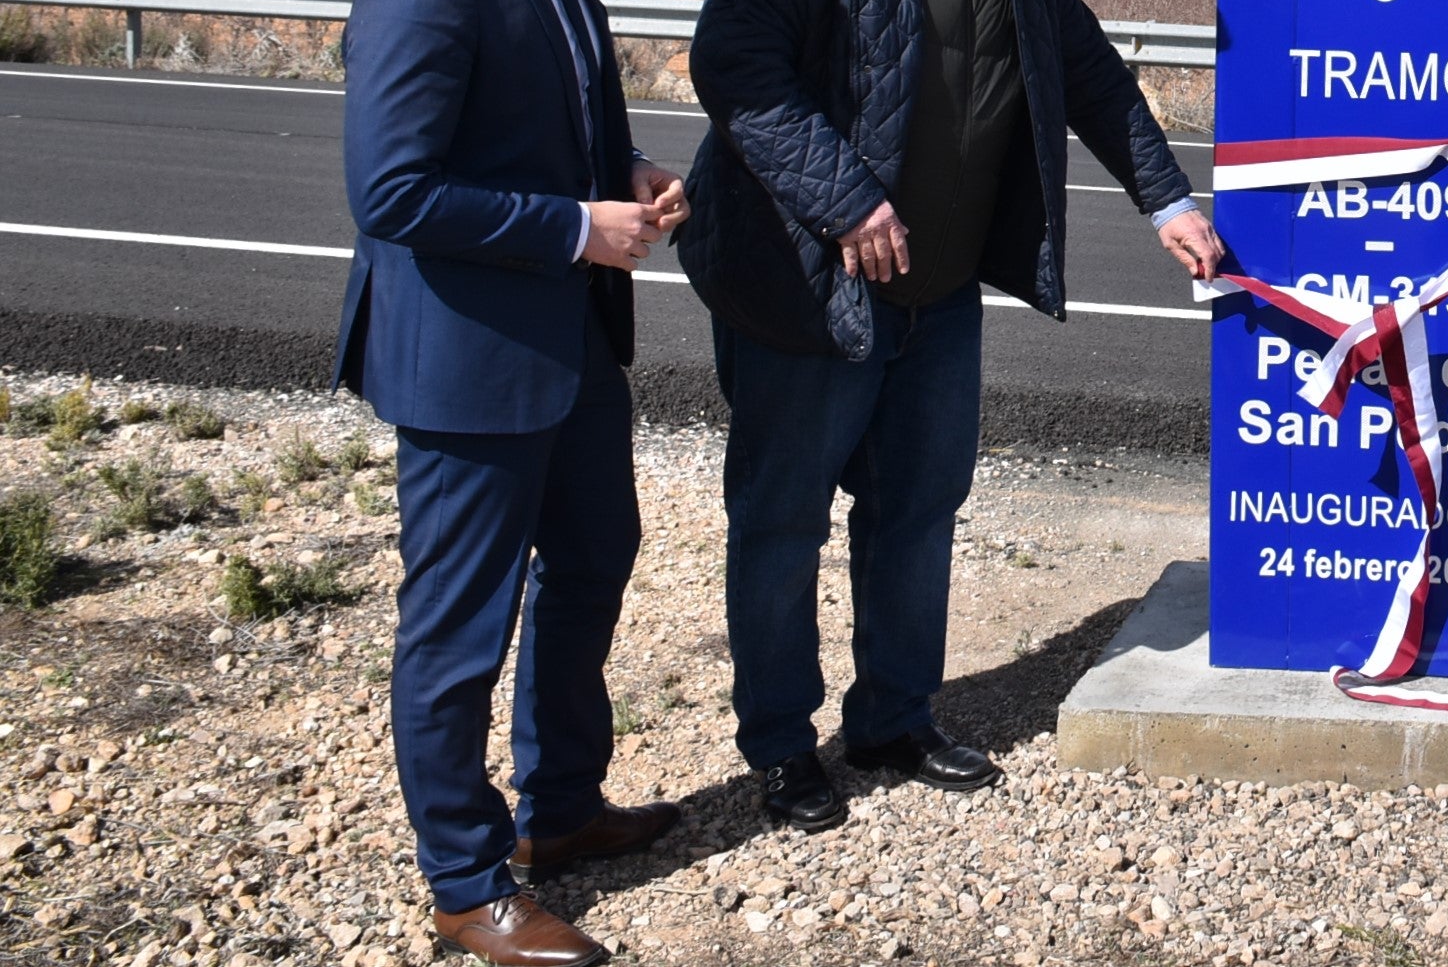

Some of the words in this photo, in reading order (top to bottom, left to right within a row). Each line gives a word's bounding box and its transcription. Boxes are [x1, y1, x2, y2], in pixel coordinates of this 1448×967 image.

[1257, 336, 1400, 386] Pea
[1238, 399, 1339, 448] San
[1259, 547, 1295, 577] 24
